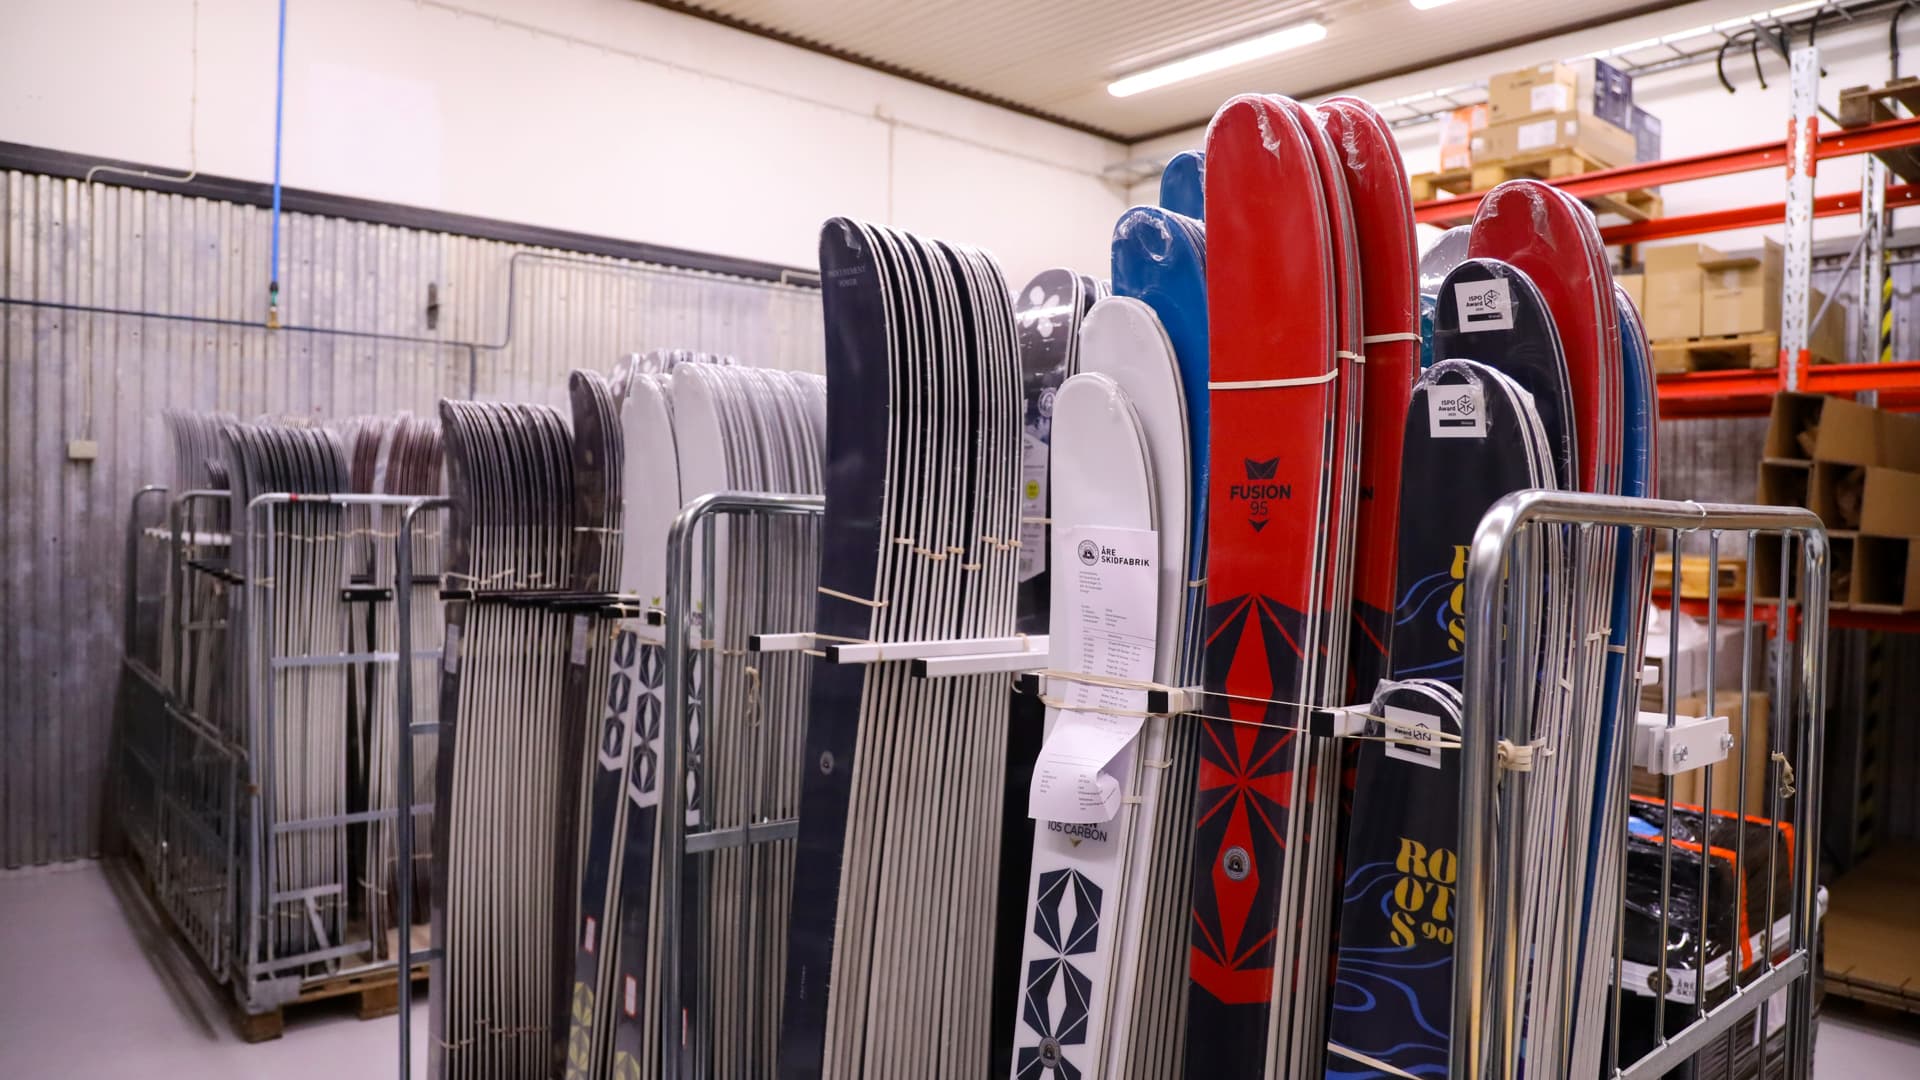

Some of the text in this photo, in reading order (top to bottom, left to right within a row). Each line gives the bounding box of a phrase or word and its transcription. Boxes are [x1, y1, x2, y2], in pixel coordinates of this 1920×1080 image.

[1230, 486, 1291, 499] FUSION
[1250, 501, 1268, 516] 95
[1101, 545, 1116, 556] ÅRE
[1101, 555, 1150, 567] SKIDFABRIK
[1063, 822, 1108, 842] CARBON
